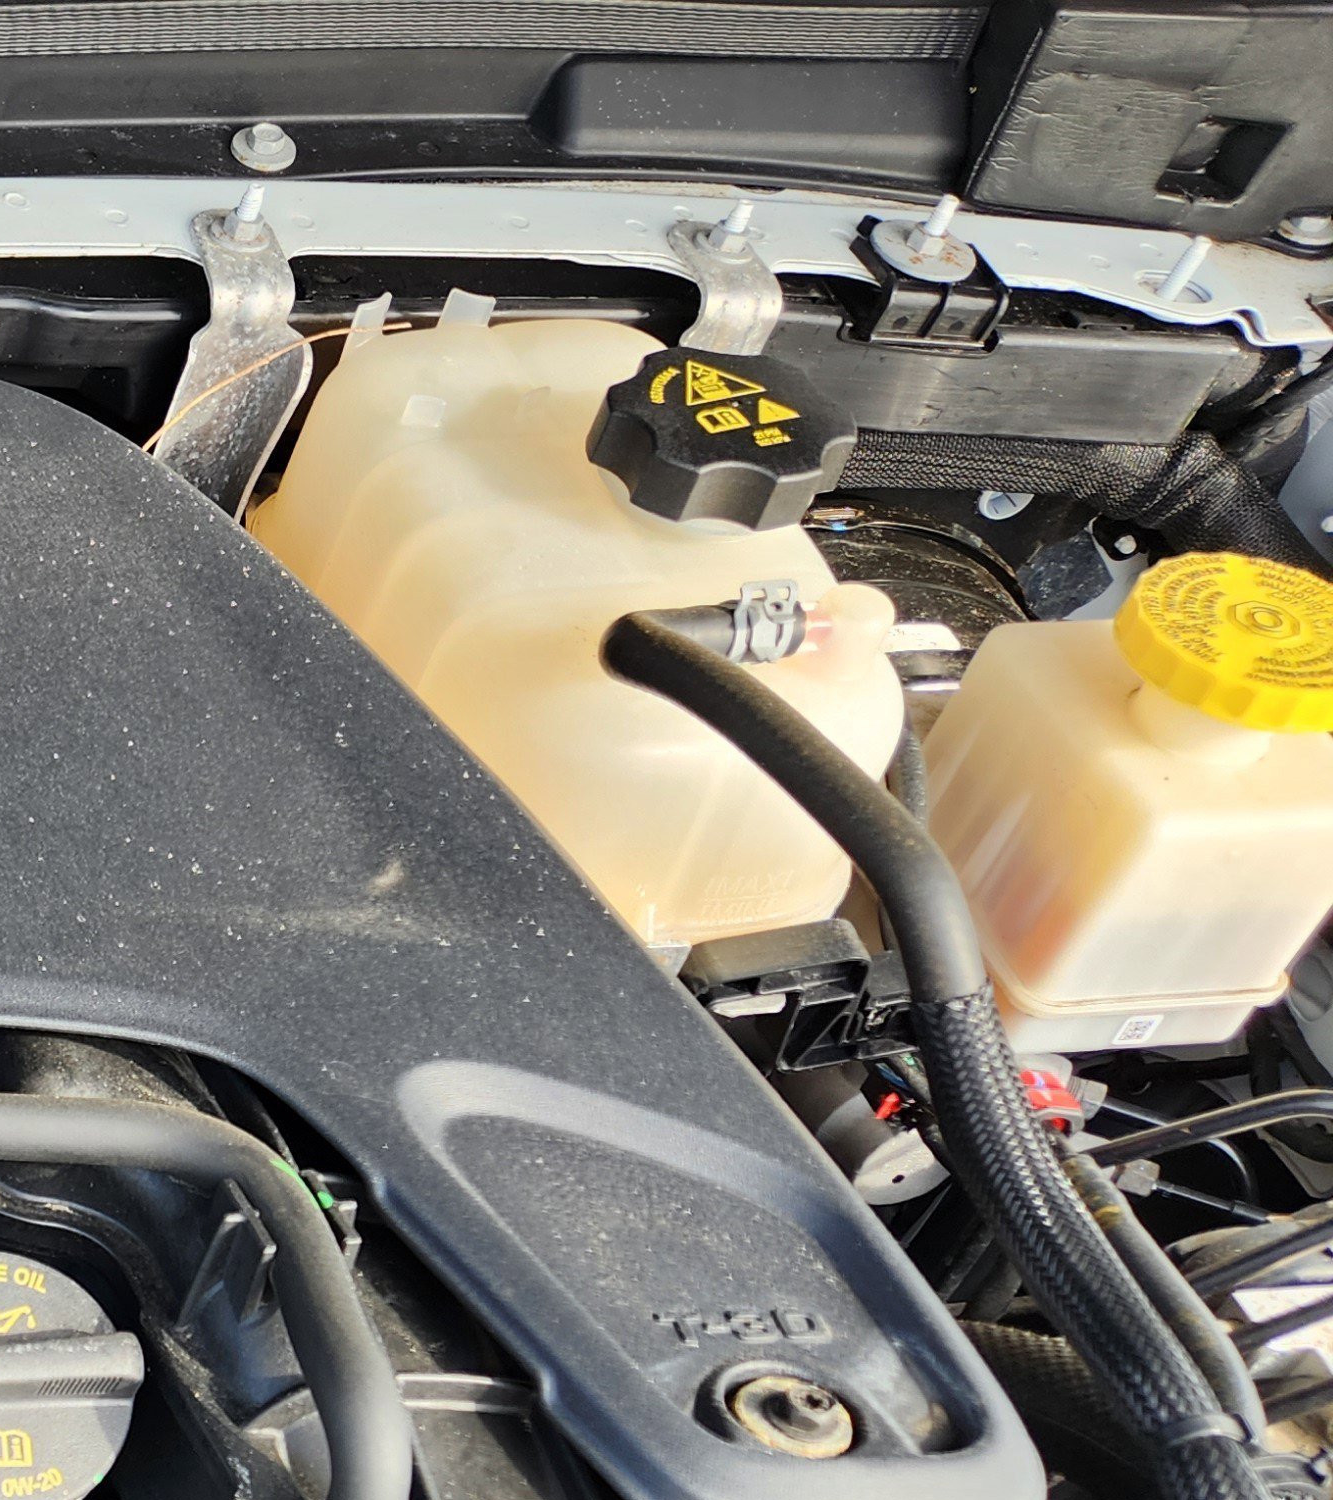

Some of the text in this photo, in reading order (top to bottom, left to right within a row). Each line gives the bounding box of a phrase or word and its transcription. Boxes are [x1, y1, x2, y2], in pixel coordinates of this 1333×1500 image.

[13, 1266, 47, 1295] OIL
[652, 1306, 833, 1347] T-30
[1, 1467, 64, 1498] 0W-20
